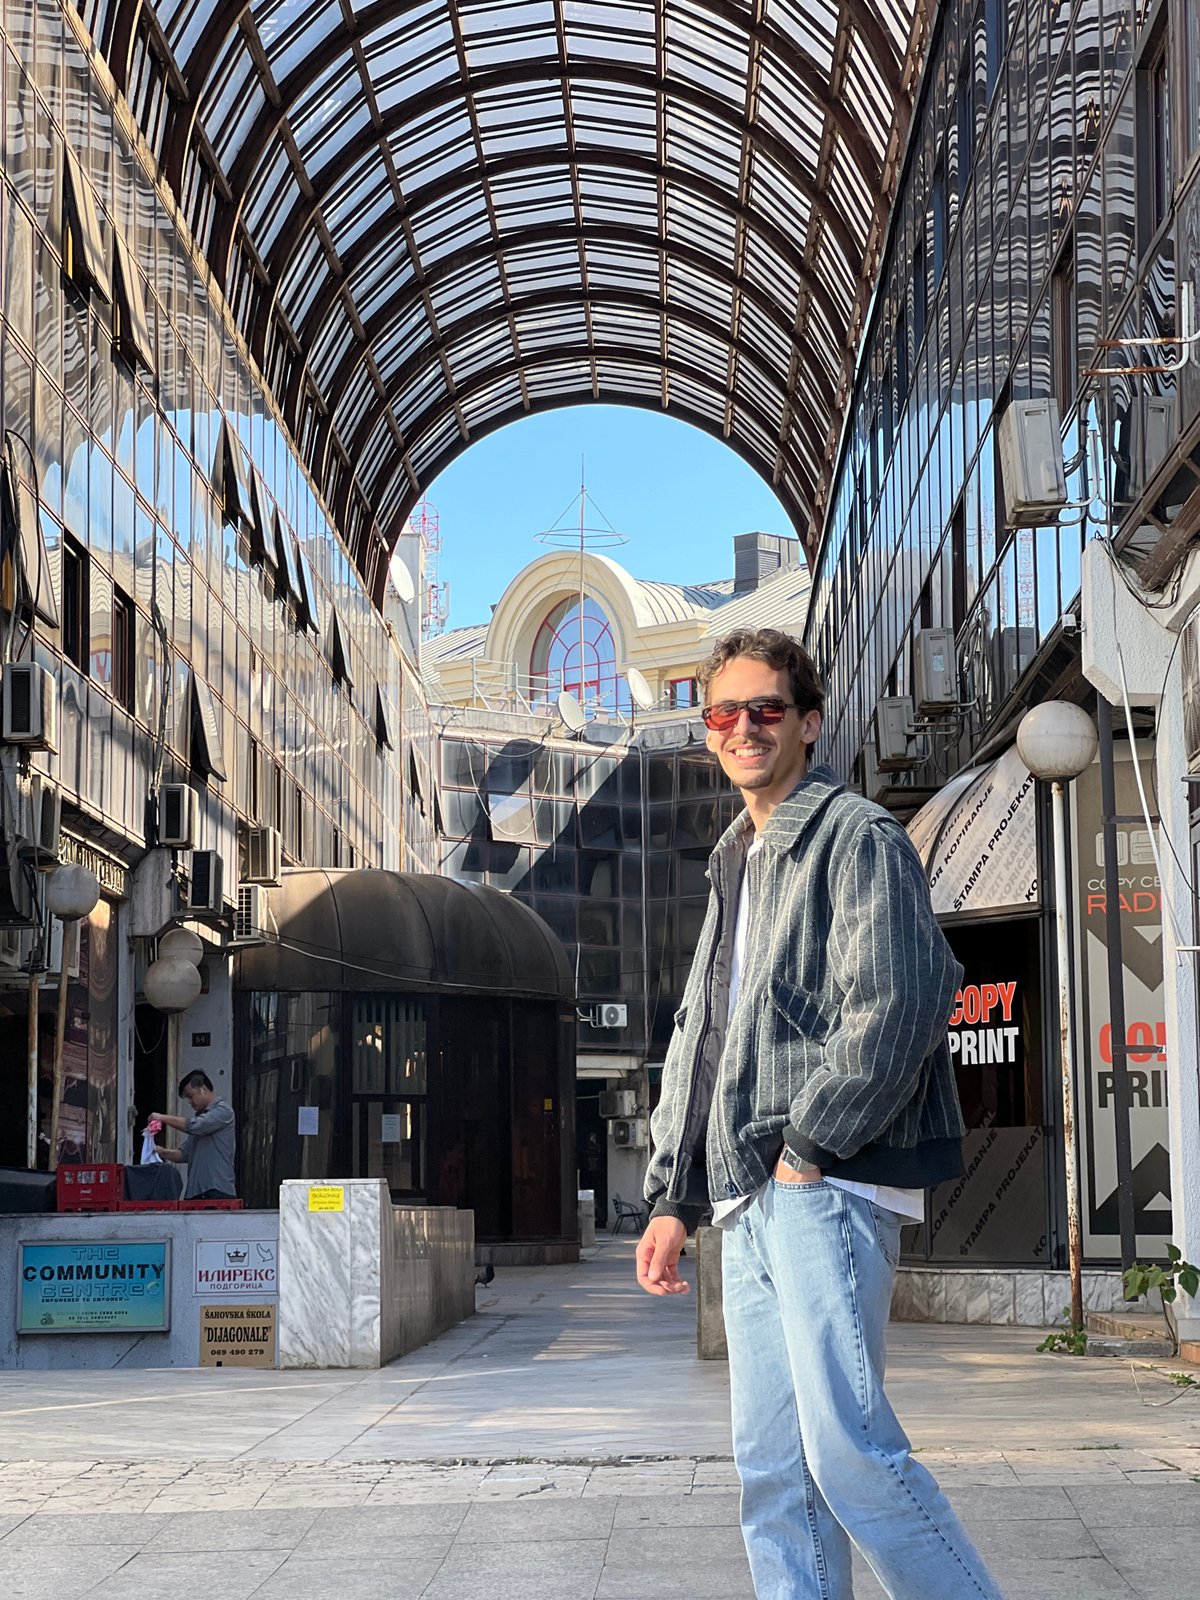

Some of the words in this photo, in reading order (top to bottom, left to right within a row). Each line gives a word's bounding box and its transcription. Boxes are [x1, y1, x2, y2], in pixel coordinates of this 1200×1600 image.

[944, 783, 995, 865] KOPIRANJE
[953, 854, 989, 912] ŠTAMPA
[948, 981, 1017, 1026] COPY
[948, 1027, 1019, 1065] PRINT
[1097, 1070, 1168, 1108] PRI
[948, 1128, 998, 1208] KOPIRANJE
[959, 1202, 997, 1256] ŠTAMPA
[23, 1264, 165, 1281] COMMUNITY
[198, 1268, 275, 1283] ИЛИРЕКС
[205, 1309, 244, 1319] ŠAHOVSKA
[246, 1308, 271, 1318] ŠKOLA
